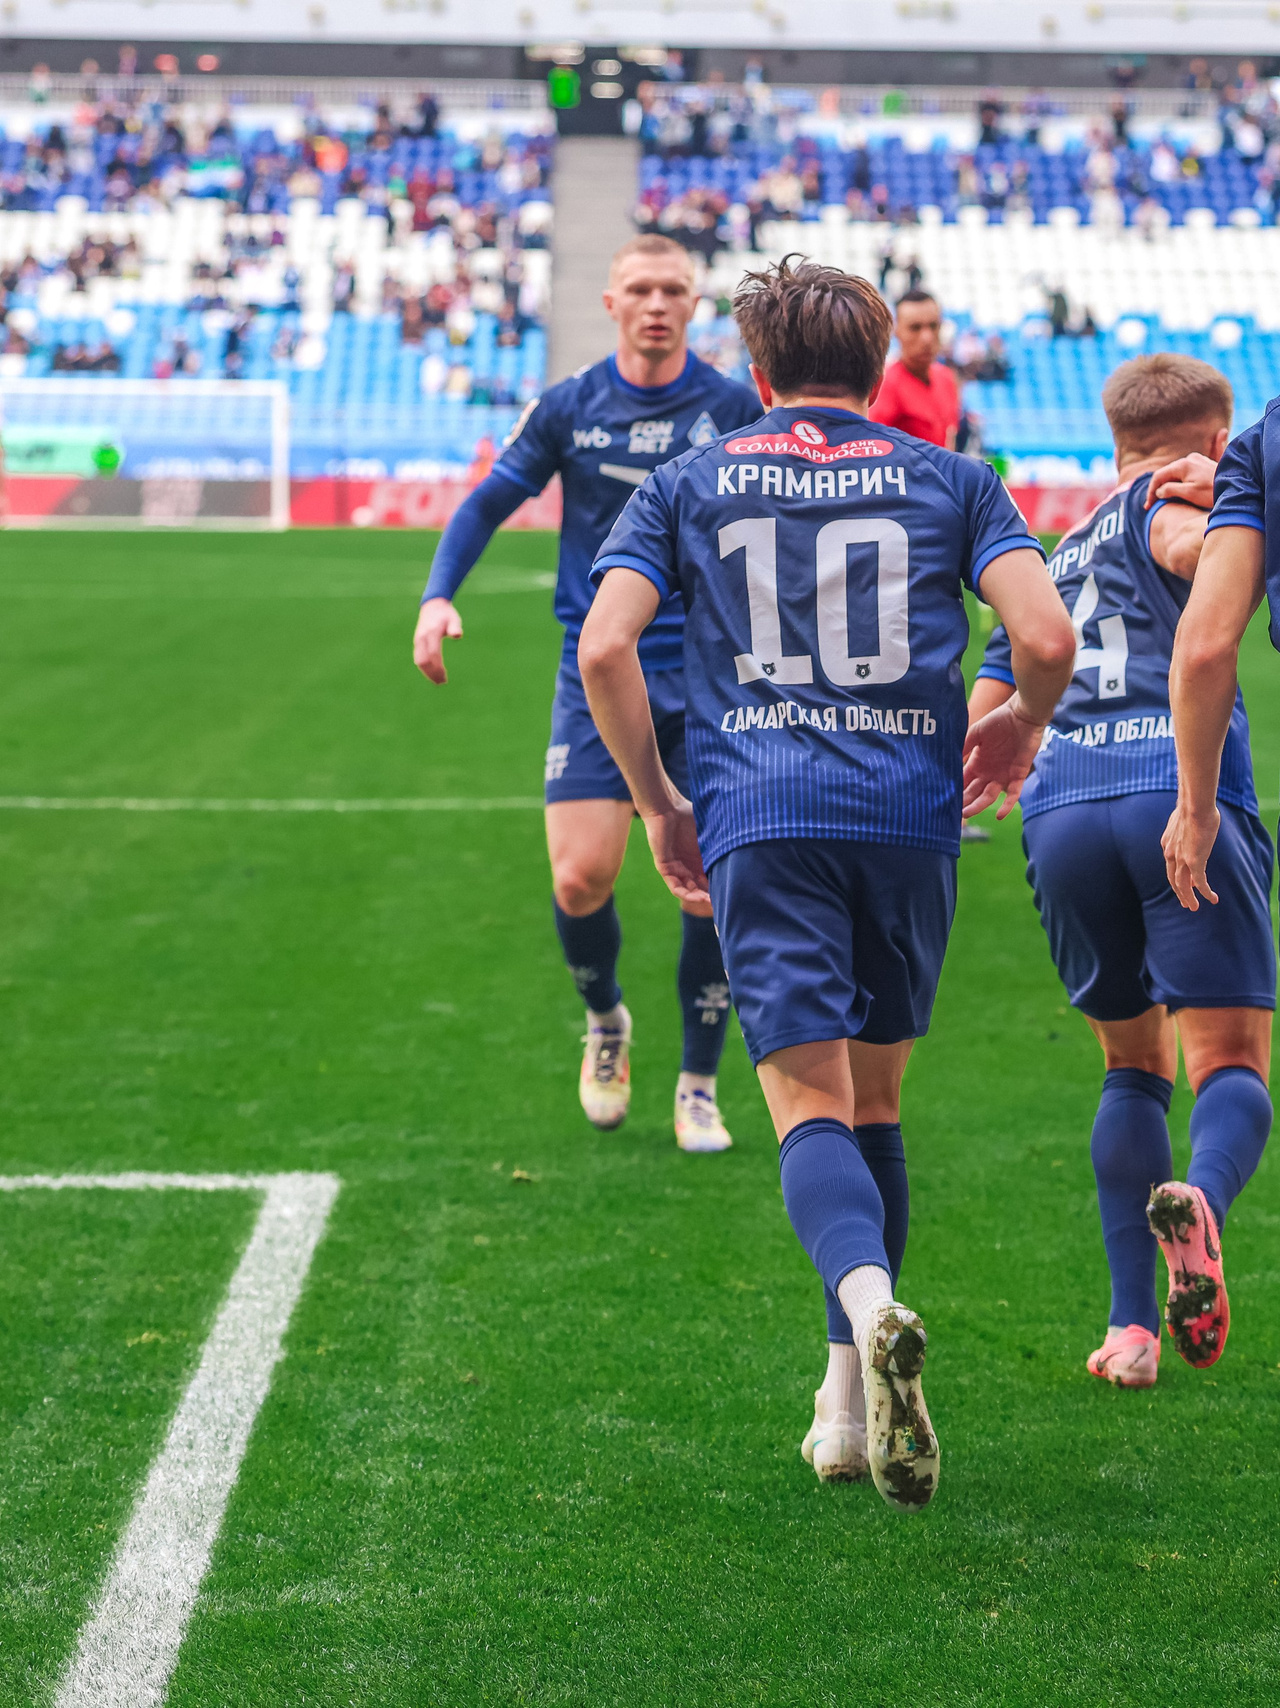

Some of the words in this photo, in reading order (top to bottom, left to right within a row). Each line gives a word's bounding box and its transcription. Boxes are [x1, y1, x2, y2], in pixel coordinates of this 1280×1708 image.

[734, 441, 883, 463] СОЛИДАРНОСТЬ
[841, 440, 876, 449] БАНК
[717, 464, 907, 498] КРАМАРИЧ
[1047, 500, 1124, 581] ОРШКО
[718, 517, 910, 687] 10
[720, 701, 838, 733] САМАРСКАЯ
[845, 705, 937, 736] ОБЛАСТЬ
